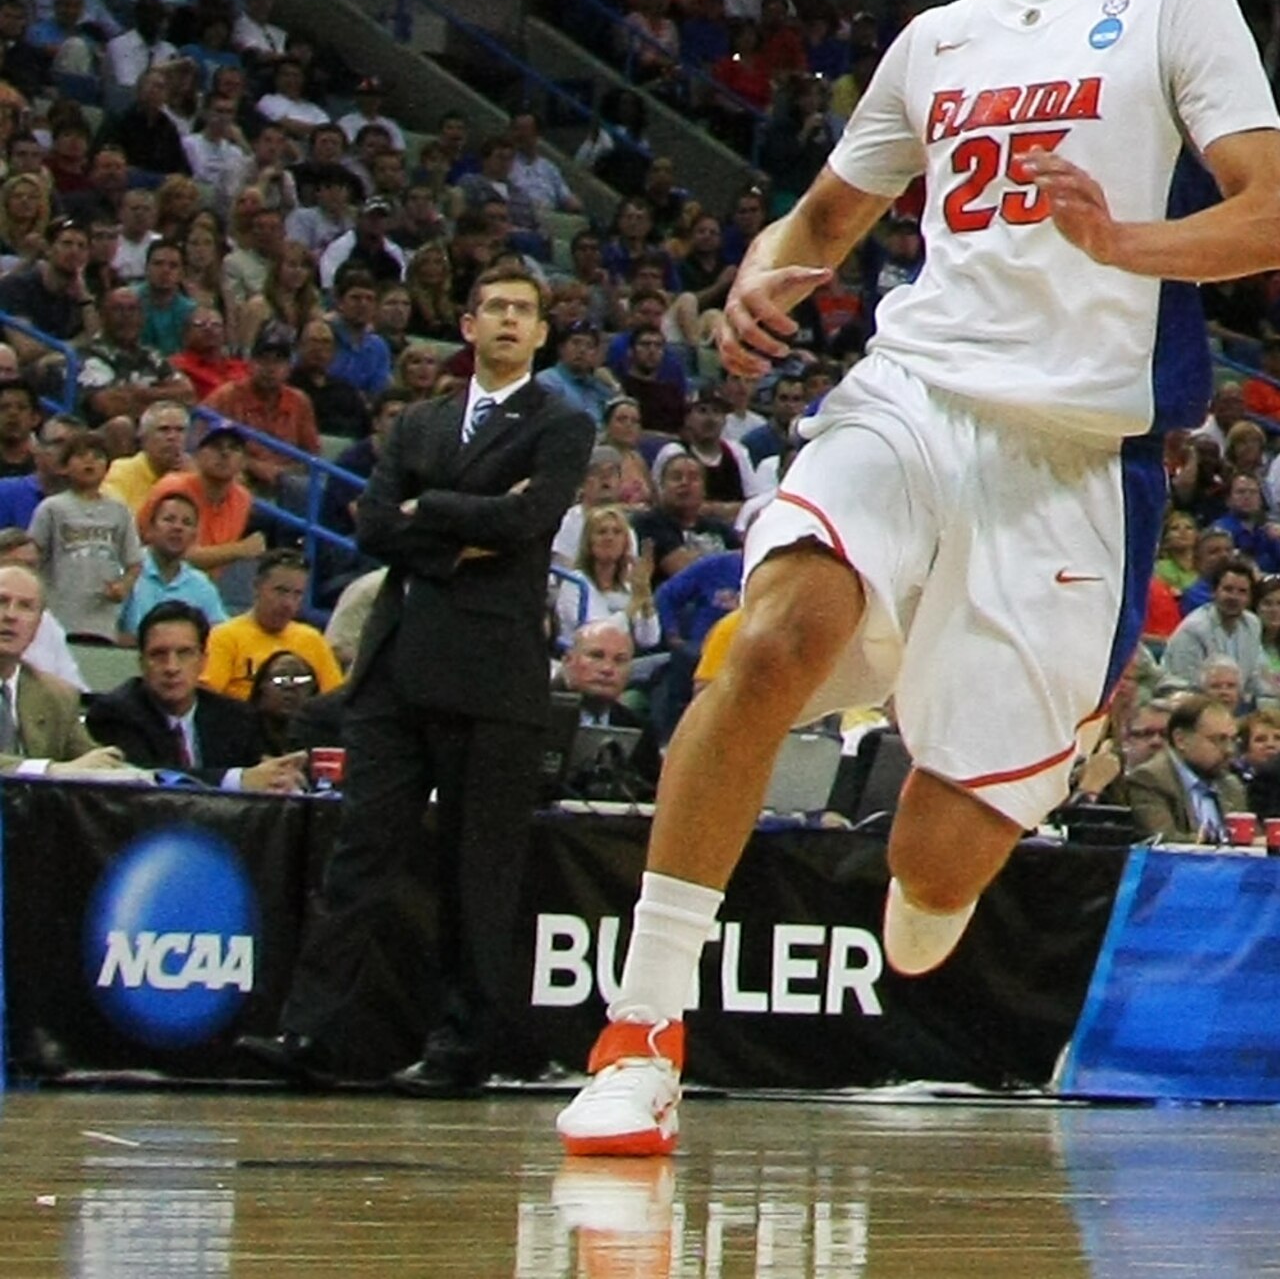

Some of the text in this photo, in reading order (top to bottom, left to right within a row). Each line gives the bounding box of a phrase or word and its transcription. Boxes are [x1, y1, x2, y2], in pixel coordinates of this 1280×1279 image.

[926, 77, 1105, 144] FLORIDA
[944, 128, 1072, 235] 25
[96, 930, 254, 993] NCAA
